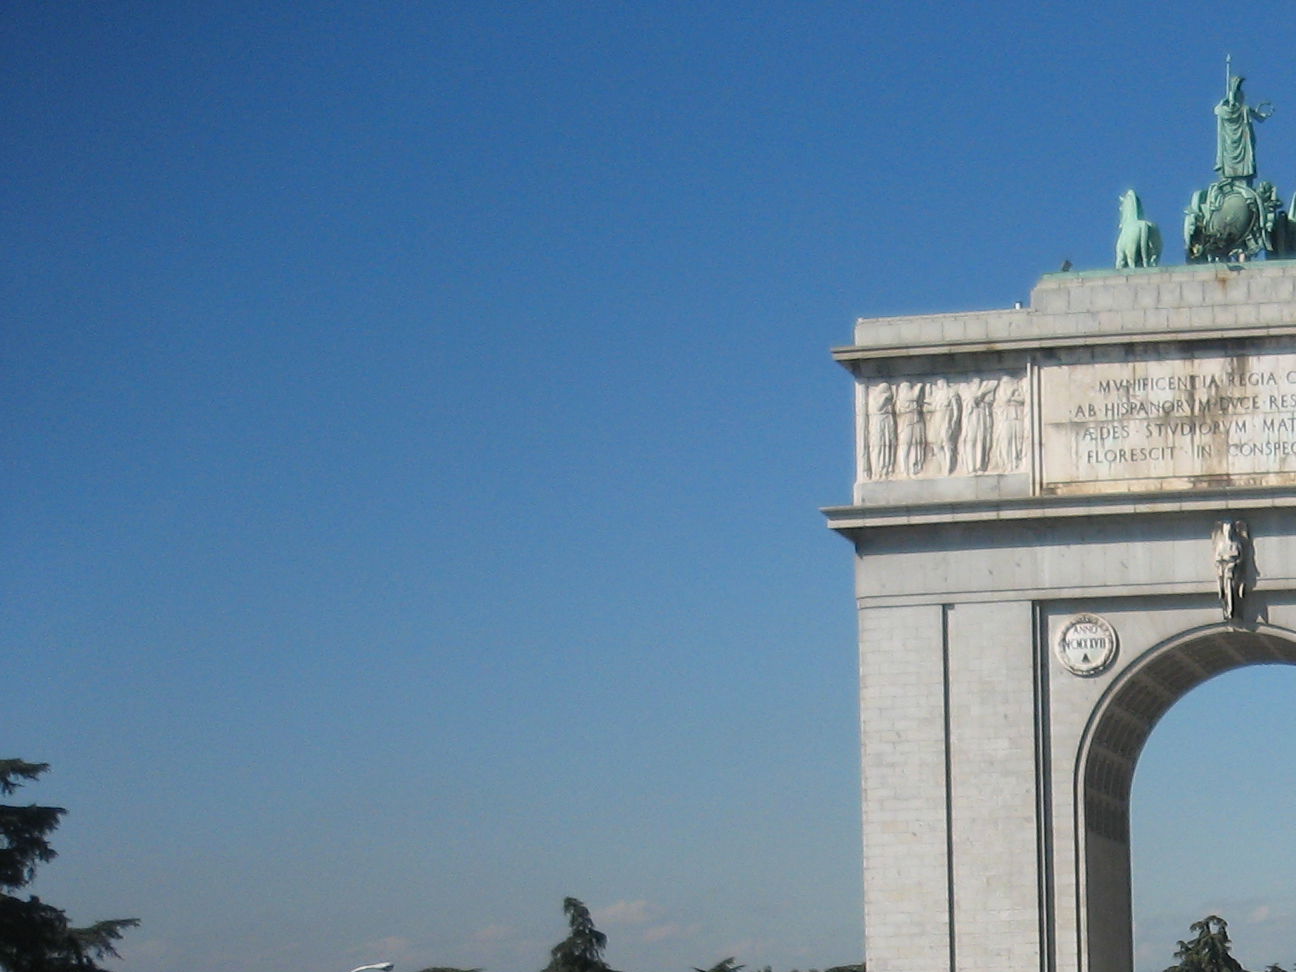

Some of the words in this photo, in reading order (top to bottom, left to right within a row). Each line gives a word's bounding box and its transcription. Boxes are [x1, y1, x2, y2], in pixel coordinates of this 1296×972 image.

[1228, 371, 1277, 387] REGIA
[1075, 404, 1097, 418] AB
[1087, 446, 1176, 464] FLORESCIT
[1196, 444, 1213, 459] IN
